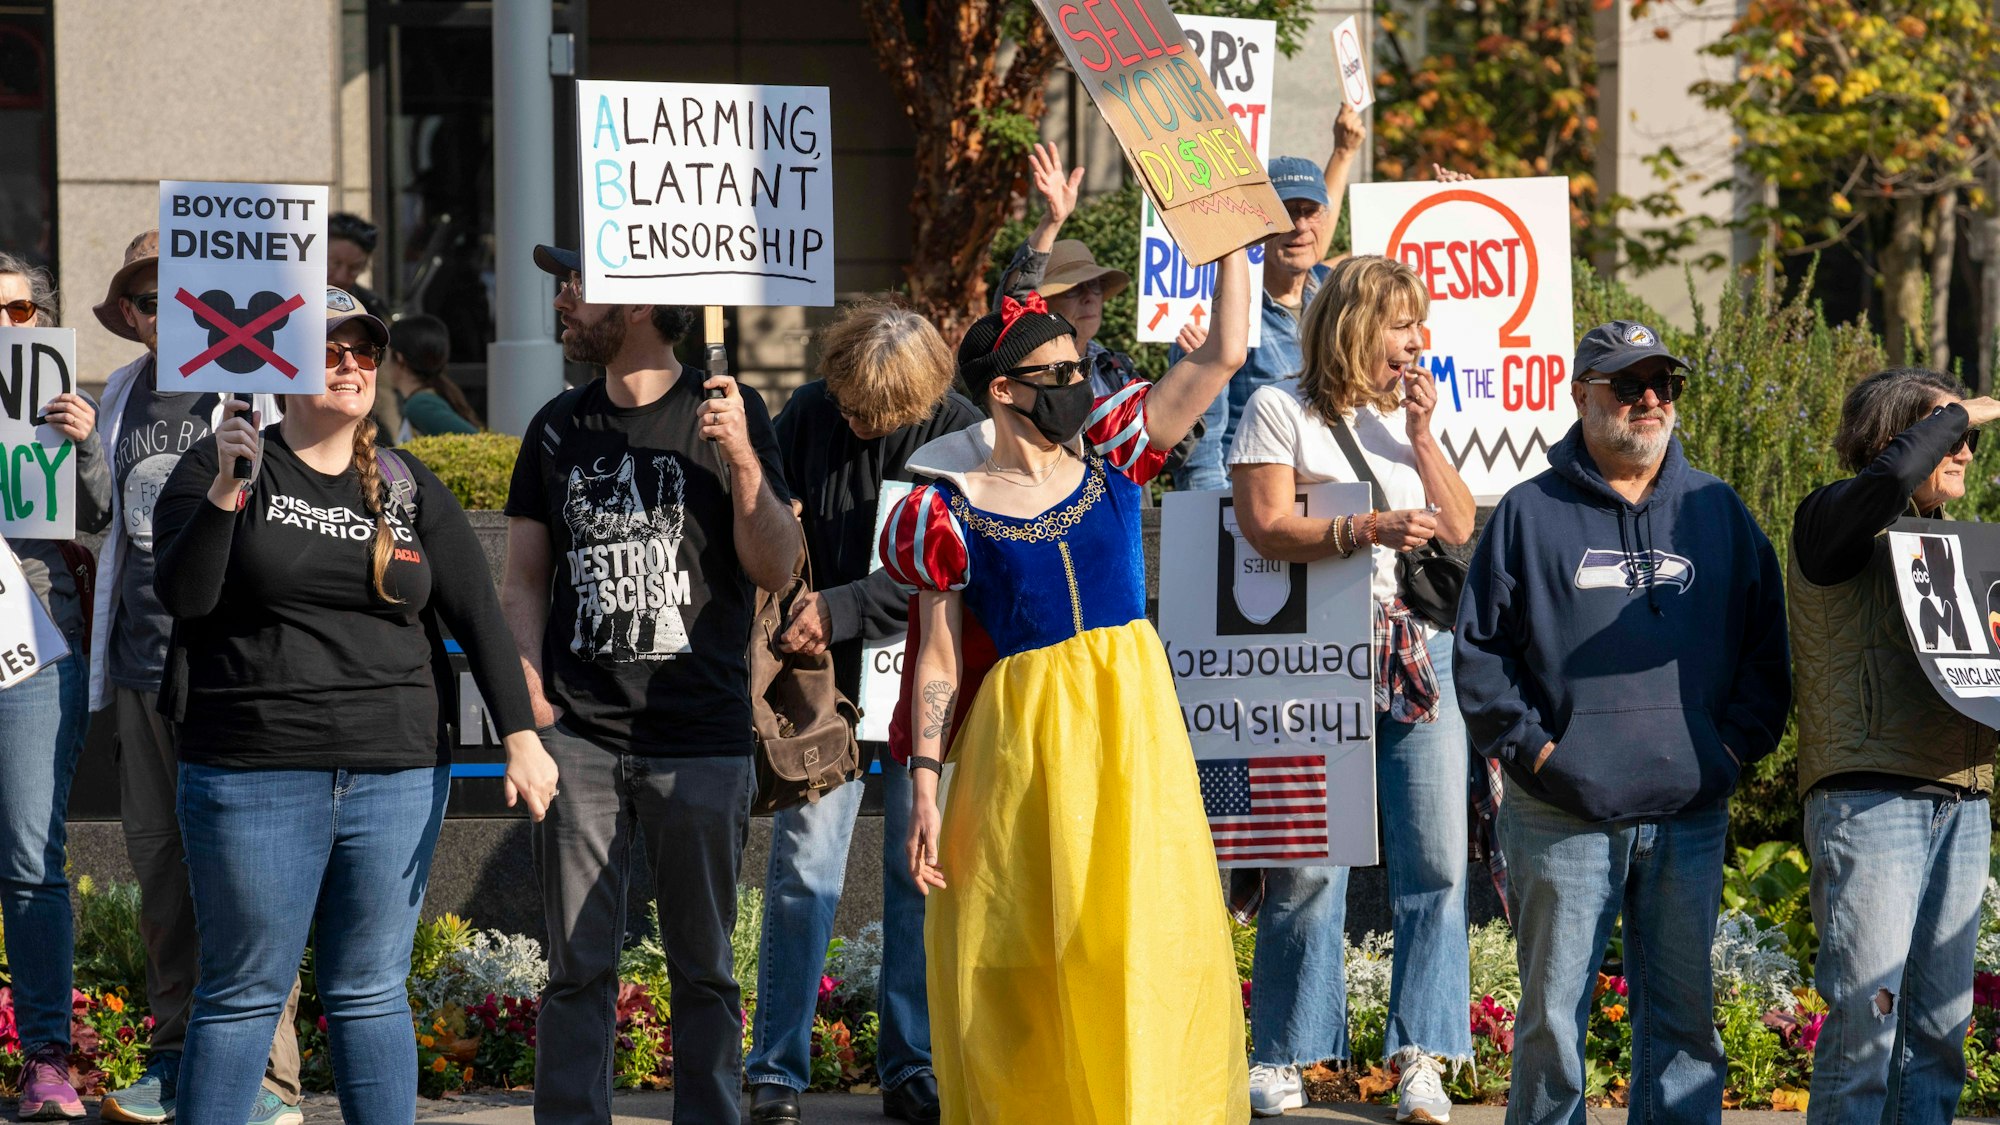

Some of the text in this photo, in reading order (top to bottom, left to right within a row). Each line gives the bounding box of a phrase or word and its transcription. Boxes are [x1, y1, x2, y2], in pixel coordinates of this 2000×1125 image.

[1057, 0, 1185, 73] SELL
[1102, 57, 1223, 140] YOUR
[593, 94, 821, 160] ALARMING,
[594, 159, 818, 210] BLATANT
[1138, 125, 1259, 202] DI$NEY
[172, 195, 315, 221] BOYCOTT
[171, 229, 317, 262] DISNEY
[596, 219, 823, 270] CENSORSHIP
[1400, 238, 1521, 301] RESIST
[1462, 369, 1495, 398] THE
[1503, 354, 1566, 412] GOP
[266, 506, 413, 543] PATRIOIC
[394, 548, 421, 564] ACLU
[566, 538, 681, 586] DESTROY
[1244, 558, 1281, 574] DIES
[1912, 568, 1930, 584] abc
[576, 570, 691, 618] FASCISM
[1181, 702, 1371, 744] This is ho
